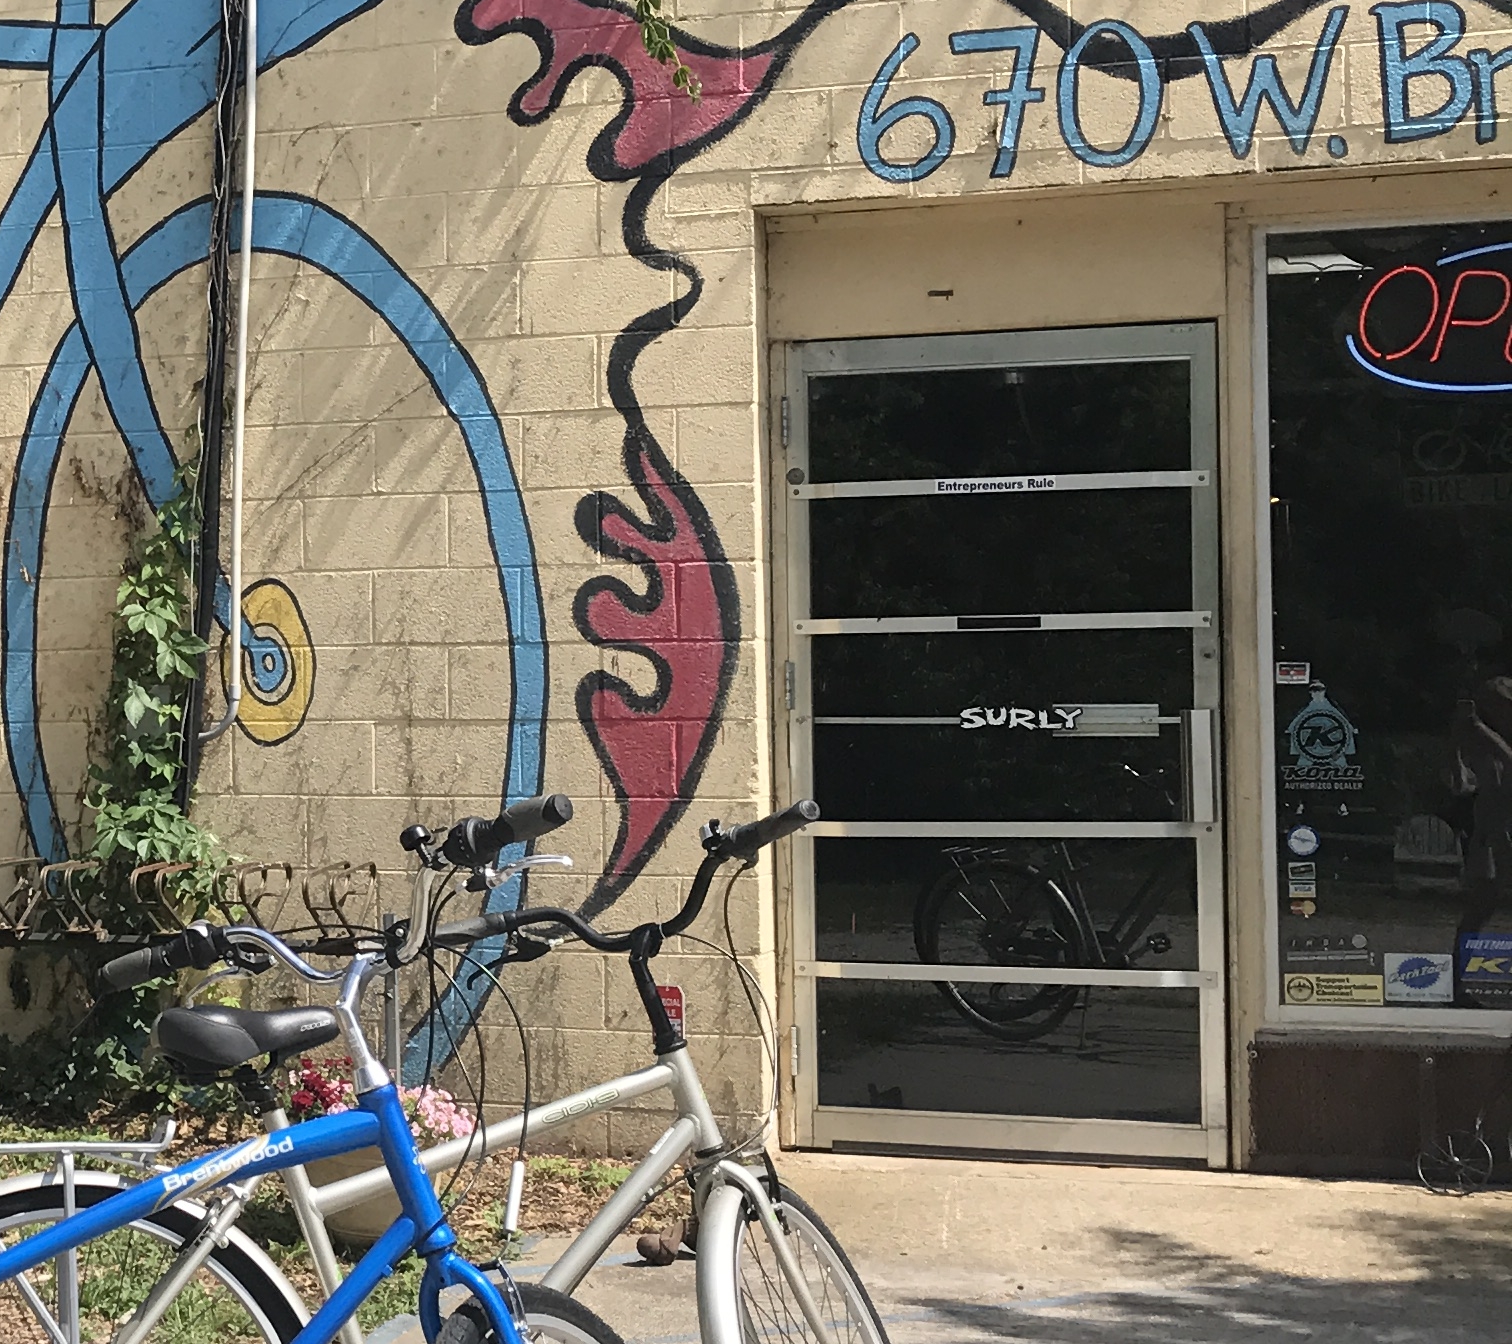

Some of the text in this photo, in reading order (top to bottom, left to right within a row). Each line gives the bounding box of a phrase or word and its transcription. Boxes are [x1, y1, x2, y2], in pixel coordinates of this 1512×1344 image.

[857, 18, 1165, 184] 670
[1188, 4, 1350, 160] W.
[1359, 265, 1512, 364] OP
[938, 478, 1055, 493] Entrepreneurs Rule
[960, 706, 1083, 731] SURLY
[1284, 782, 1364, 791] AUTHORIZED DEALER
[1465, 956, 1512, 974] K
[161, 1135, 295, 1192] Brentwood
